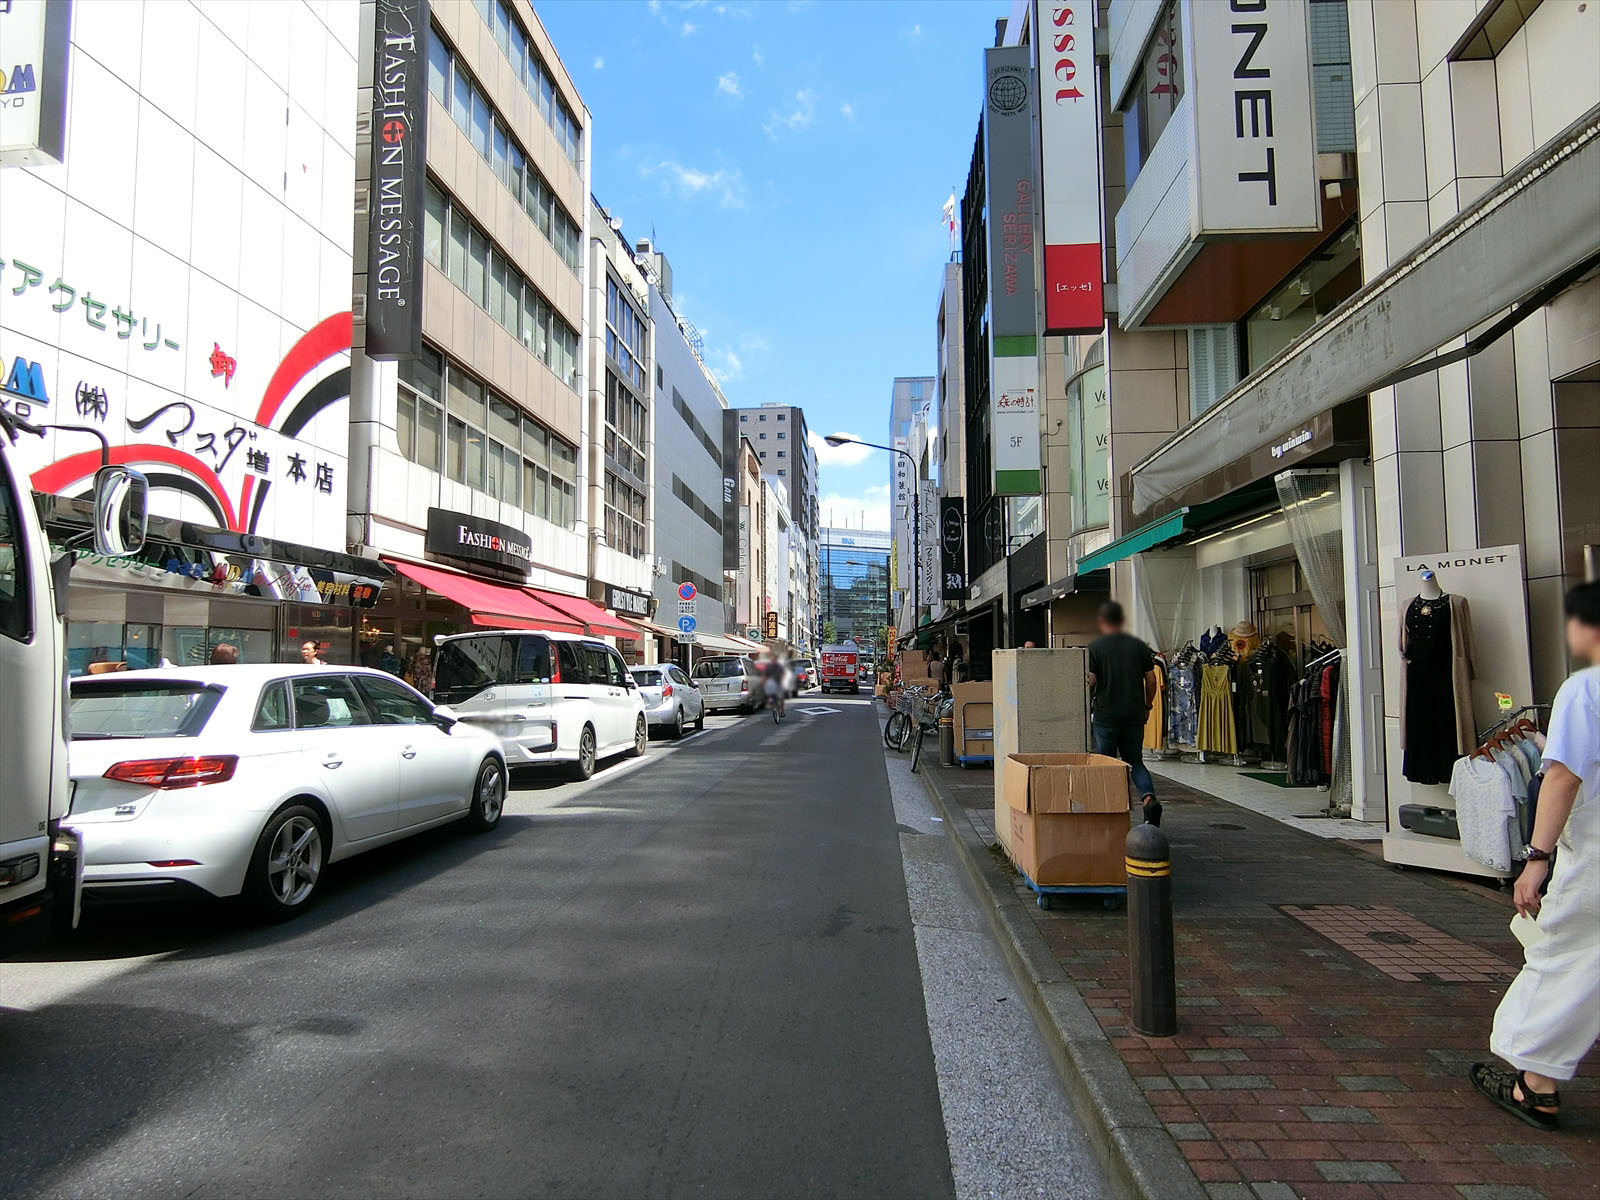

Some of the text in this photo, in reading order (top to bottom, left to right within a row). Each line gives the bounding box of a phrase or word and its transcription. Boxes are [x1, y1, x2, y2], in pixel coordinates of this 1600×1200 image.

[1053, 0, 1085, 106] sset
[382, 34, 416, 166] FASHION
[1230, 0, 1278, 206] NET
[1002, 214, 1018, 296] SERIZAWA
[1017, 180, 1033, 256] GALLERY
[0, 256, 180, 350] アクセサリー
[209, 342, 237, 389] 卸
[1010, 436, 1023, 447] 5F
[458, 524, 506, 552] FASHION
[1406, 554, 1509, 572] LA MONET
